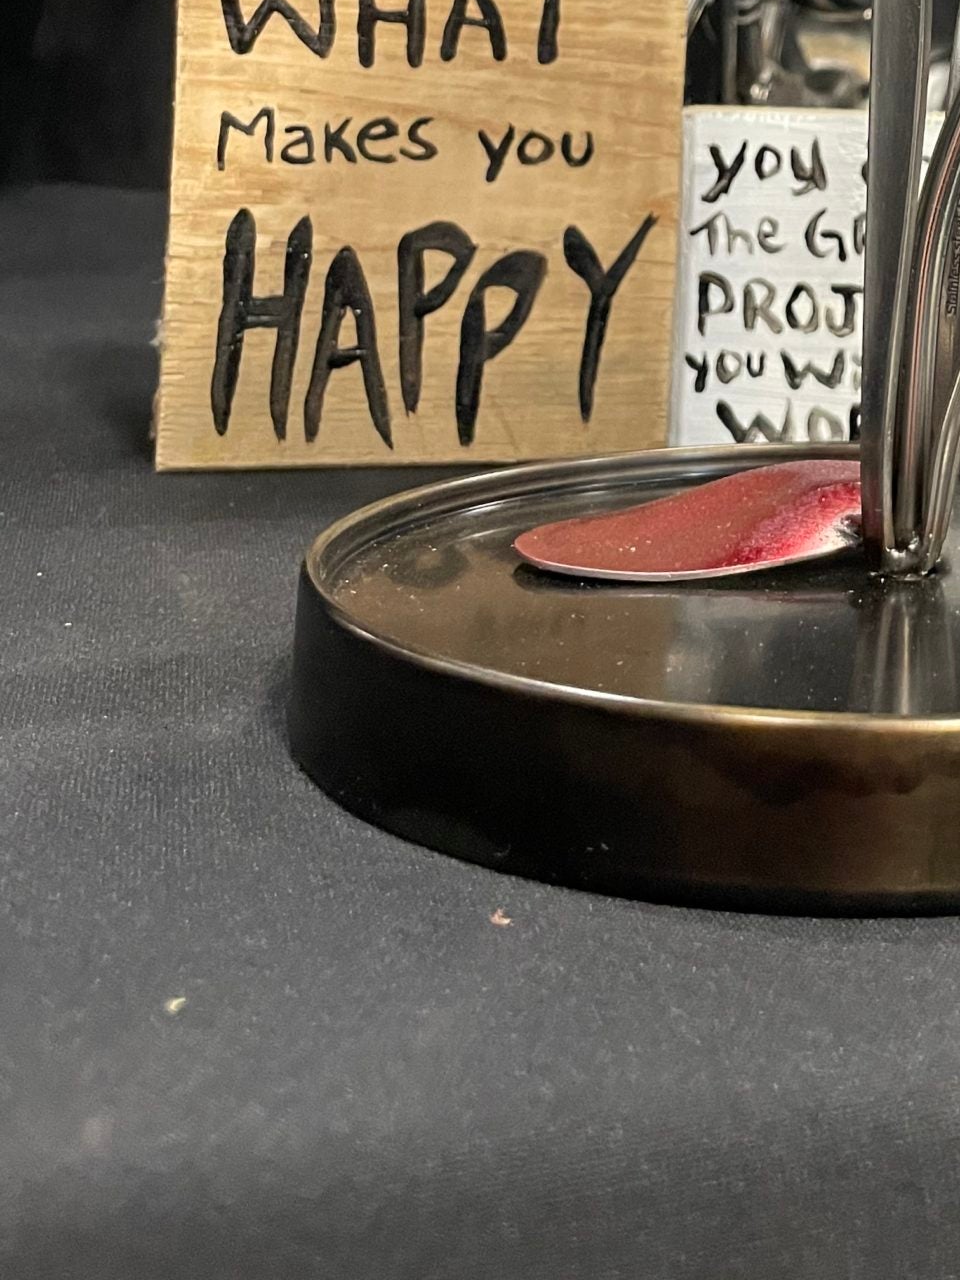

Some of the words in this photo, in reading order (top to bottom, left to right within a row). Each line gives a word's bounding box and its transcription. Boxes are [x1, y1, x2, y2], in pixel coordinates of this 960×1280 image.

[477, 124, 593, 181] you
[210, 207, 661, 450] HAPPY
[698, 270, 864, 338] PROJ
